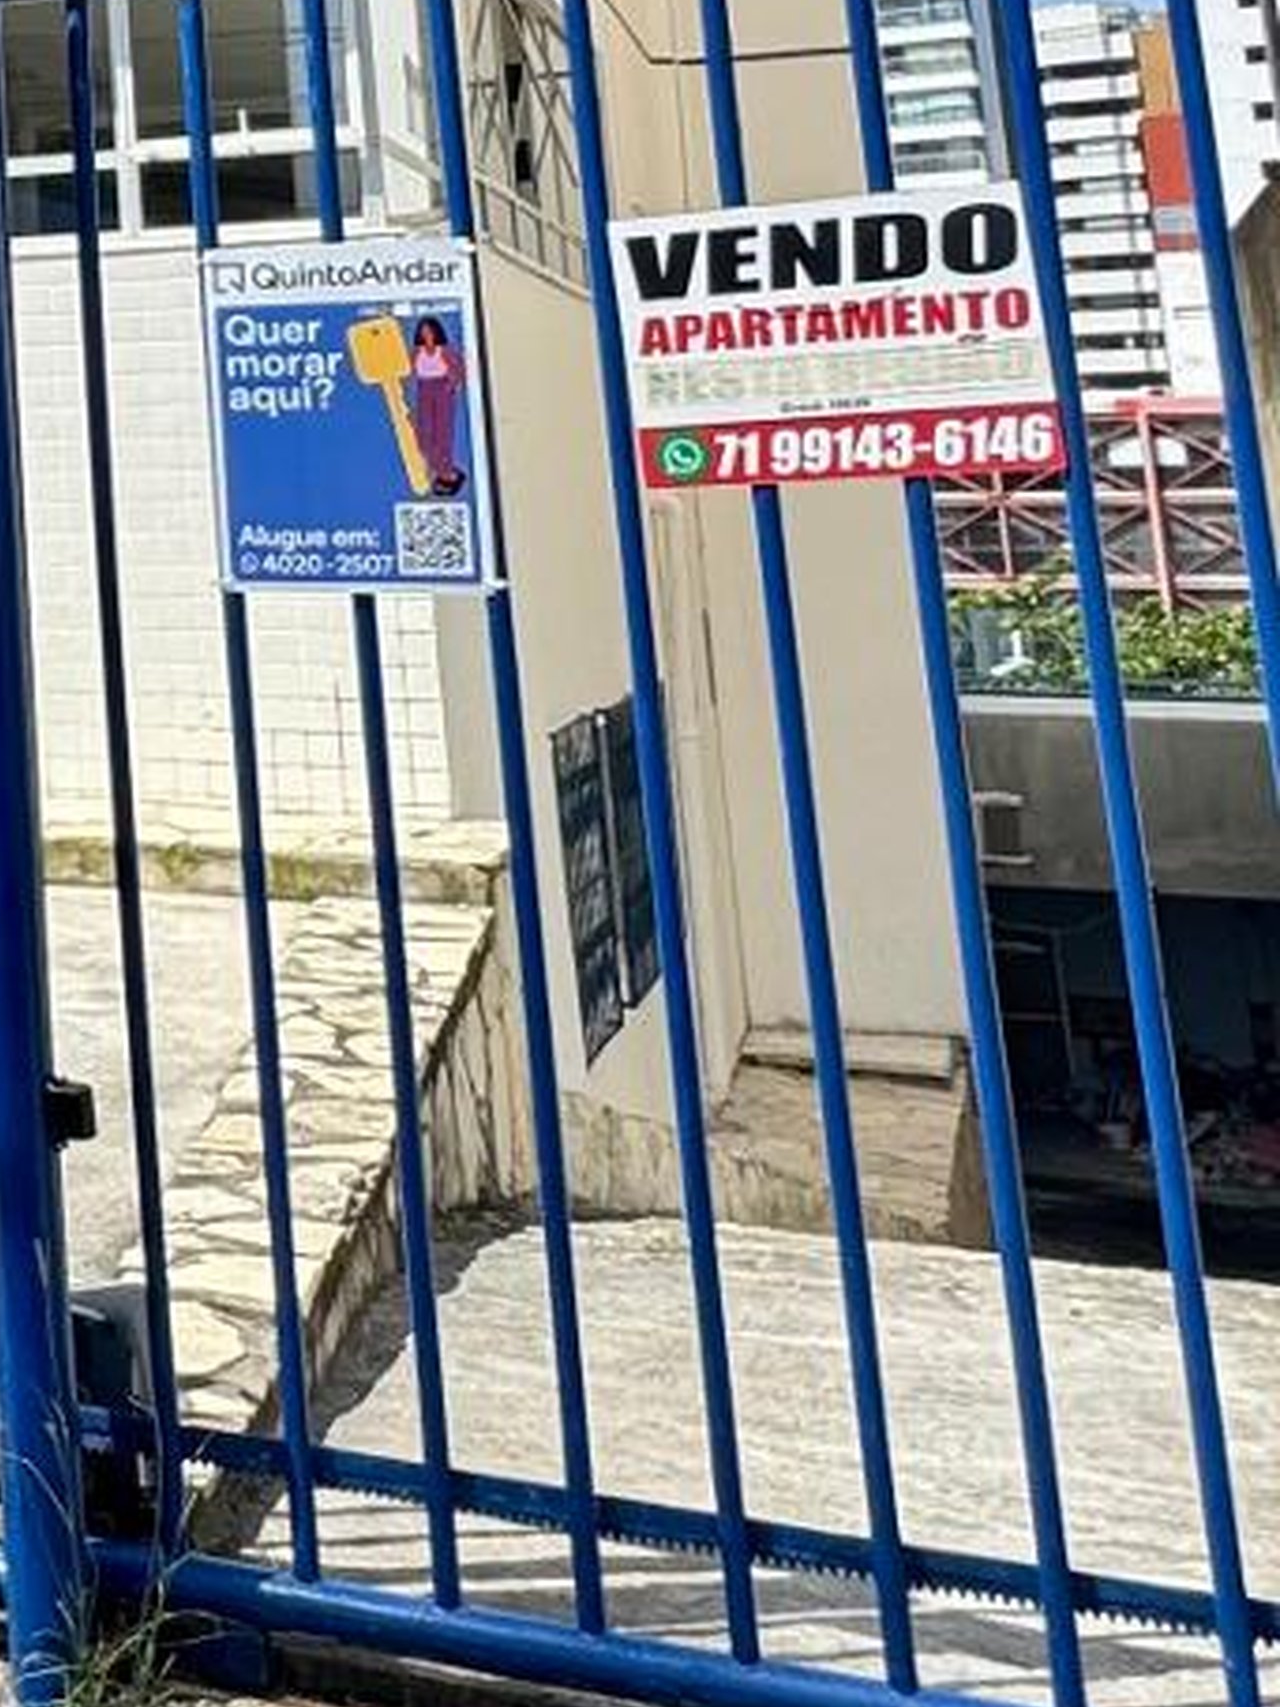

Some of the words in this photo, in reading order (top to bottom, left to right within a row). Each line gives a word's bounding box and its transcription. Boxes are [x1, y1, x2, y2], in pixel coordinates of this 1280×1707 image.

[626, 202, 1018, 301] VENDO
[251, 260, 460, 290] QuintoAndar
[224, 315, 322, 346] Quer
[641, 288, 1031, 357] APARTAMENTO
[226, 352, 343, 379] morar
[228, 379, 335, 416] aqui?
[714, 432, 760, 477] 71
[770, 414, 1054, 474] 99143-6146
[239, 524, 327, 552] Alugue
[332, 528, 381, 547] em:
